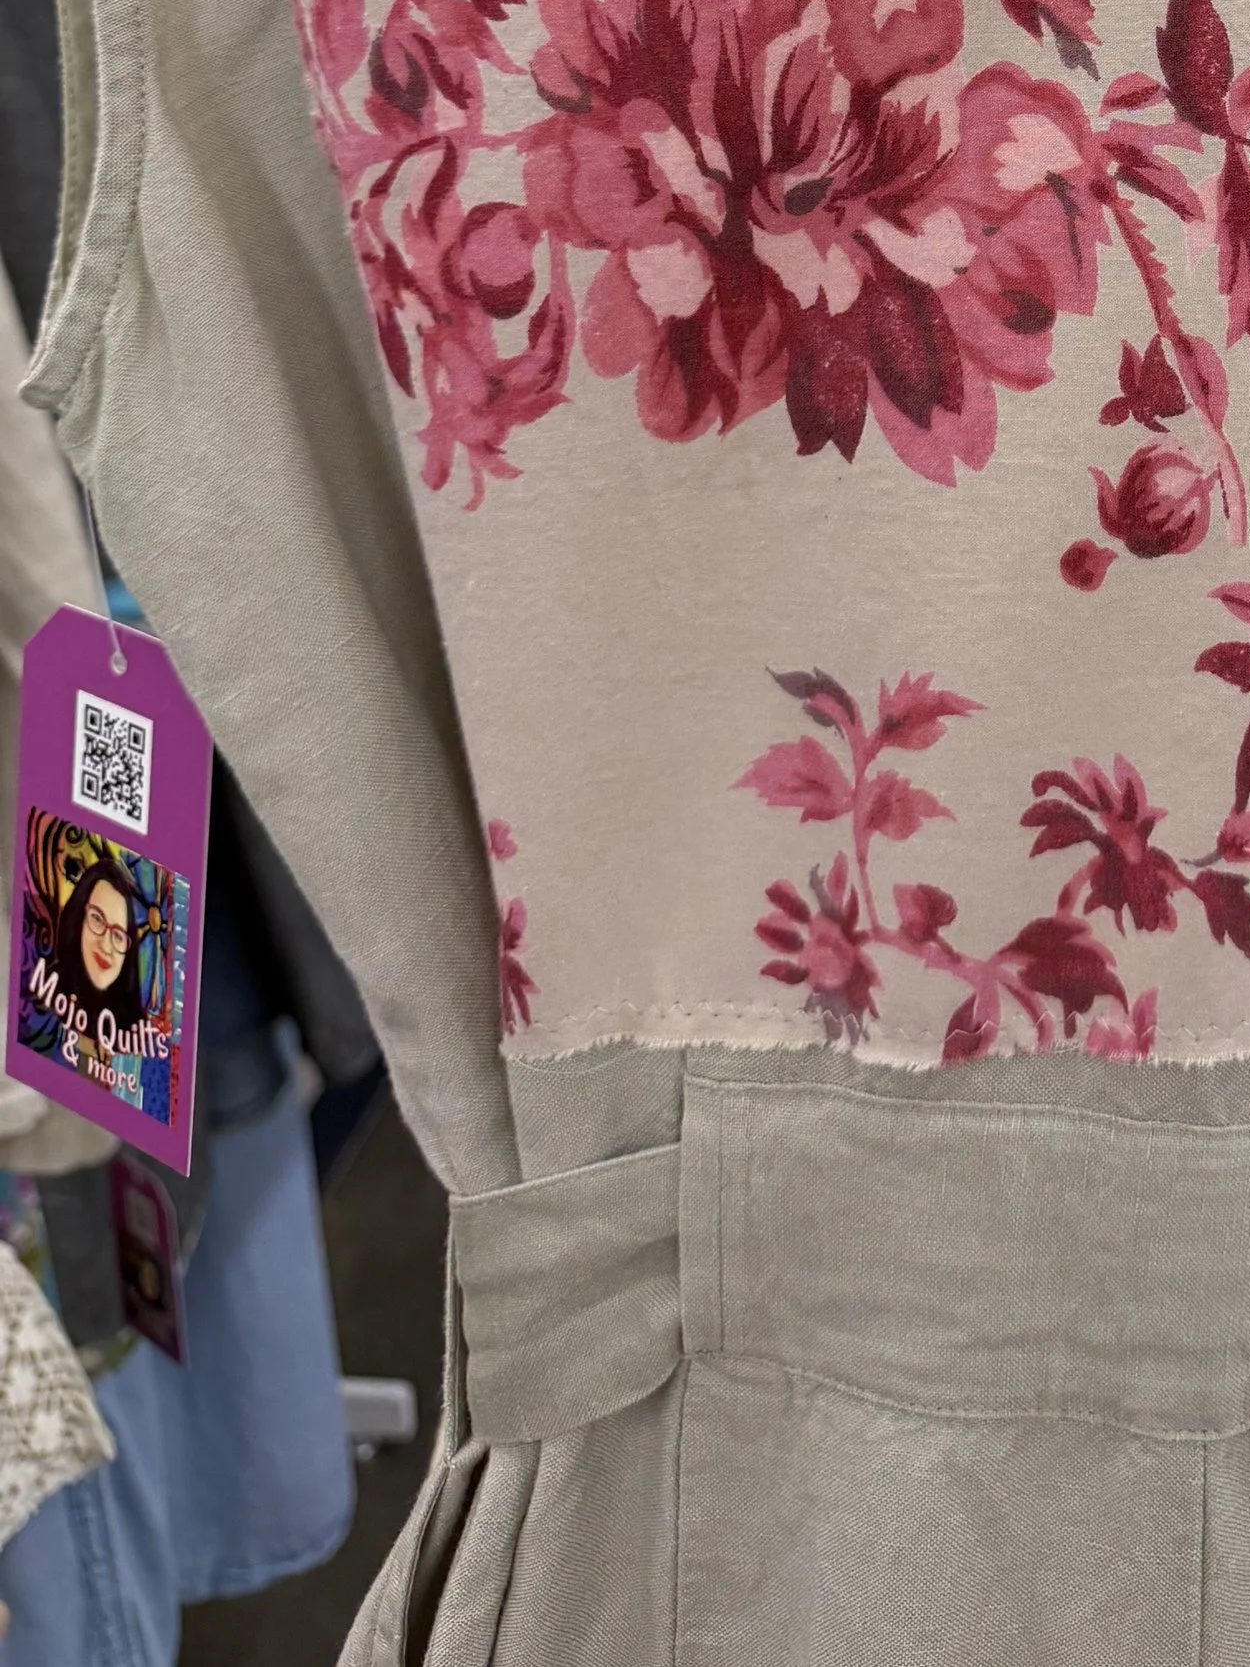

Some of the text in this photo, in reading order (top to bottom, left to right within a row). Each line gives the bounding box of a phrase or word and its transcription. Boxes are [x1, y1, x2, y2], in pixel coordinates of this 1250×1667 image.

[29, 957, 171, 1060] Mojo Quilts
[62, 1030, 137, 1092] & more
